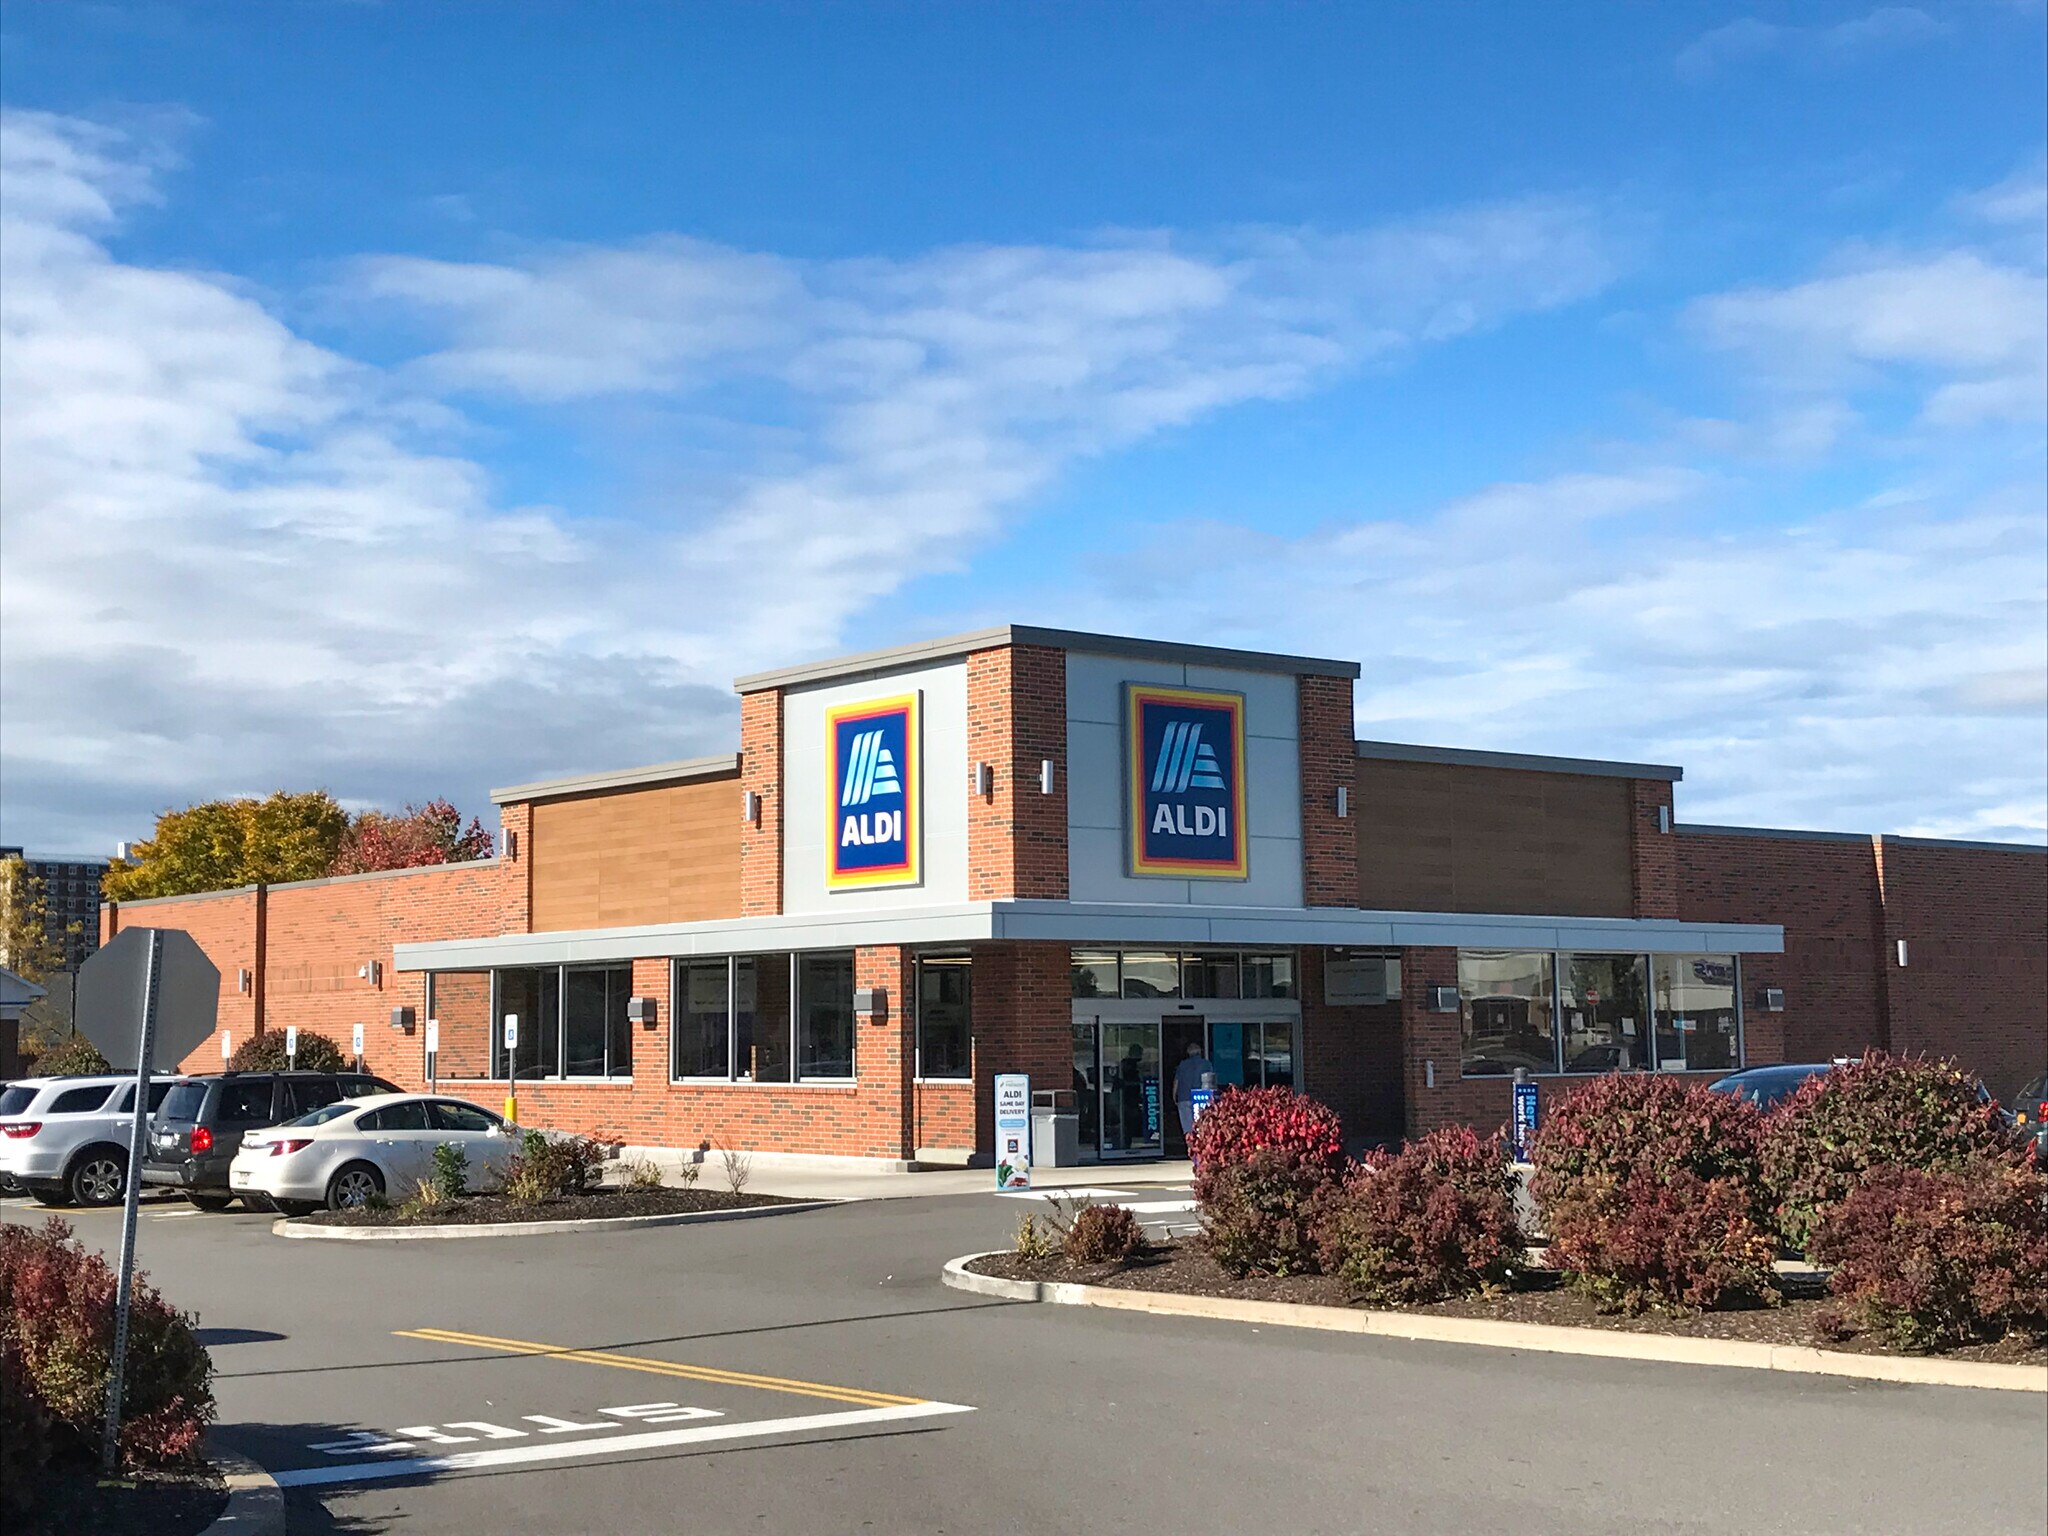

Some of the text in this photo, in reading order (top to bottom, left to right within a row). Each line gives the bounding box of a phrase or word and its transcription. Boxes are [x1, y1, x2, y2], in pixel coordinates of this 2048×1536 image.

[841, 810, 902, 847] ALDI
[1152, 803, 1227, 837] ALDI
[1003, 1090, 1022, 1098] ALDI
[1518, 1095, 1526, 1122] work
[307, 1402, 726, 1455] STOP
